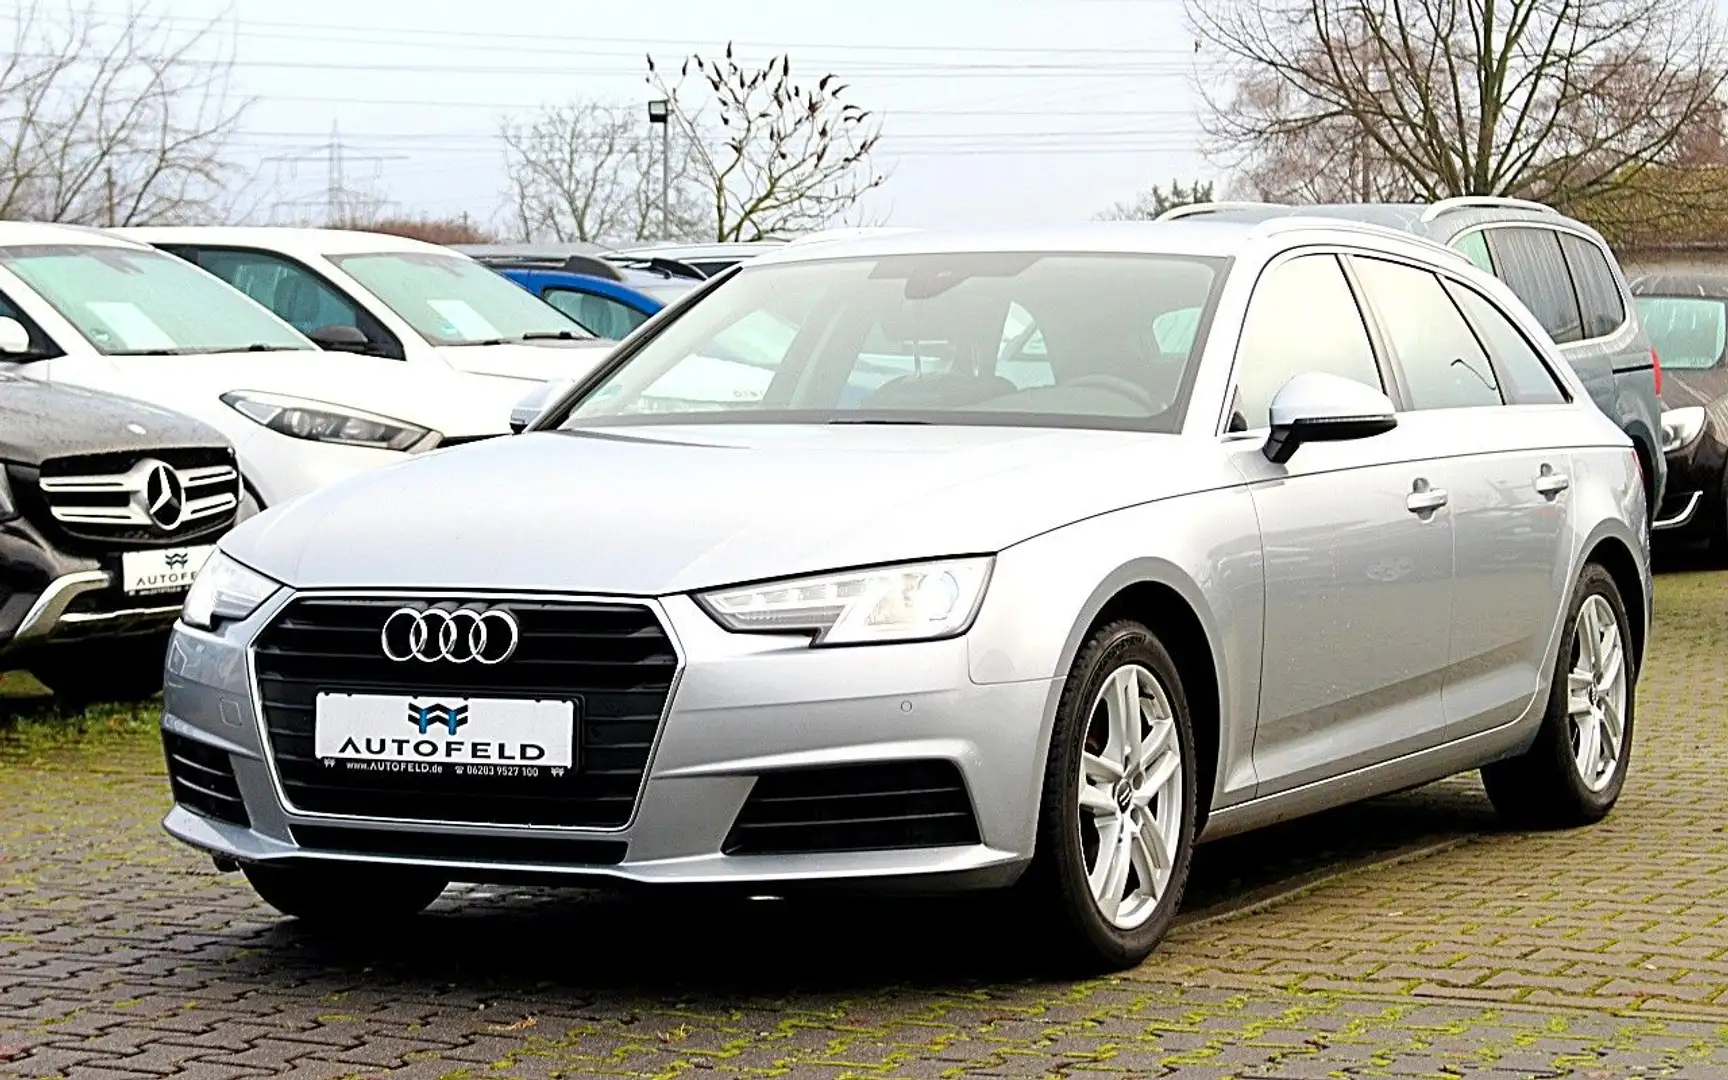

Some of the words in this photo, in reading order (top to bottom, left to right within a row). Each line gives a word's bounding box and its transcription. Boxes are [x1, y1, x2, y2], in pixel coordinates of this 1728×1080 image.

[338, 736, 546, 762] AUTOFELD
[345, 761, 443, 774] www.AUTOFELD.de
[466, 765, 495, 776] 06203
[497, 766, 519, 777] 9527
[522, 767, 539, 777] 100
